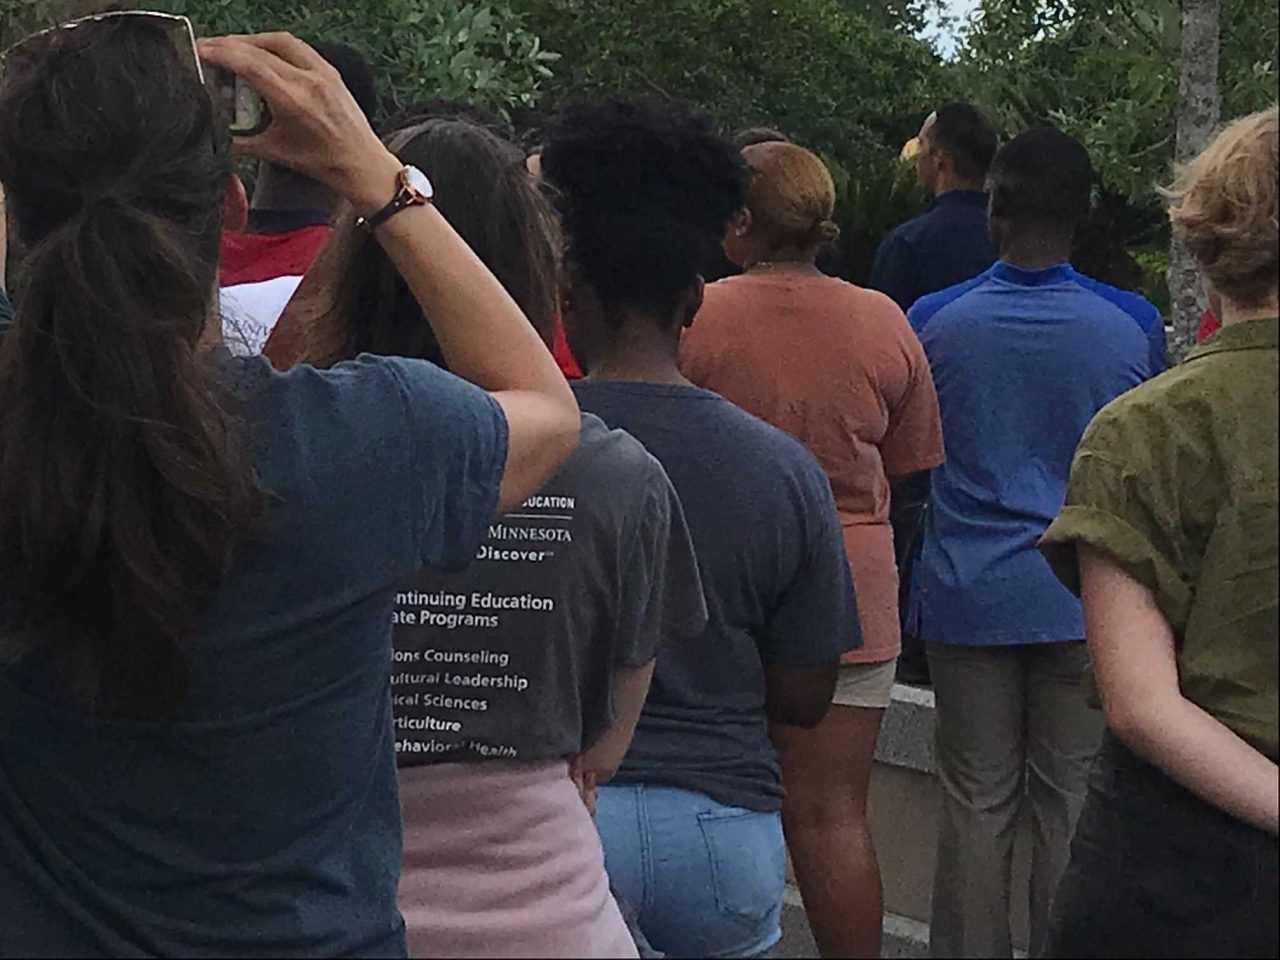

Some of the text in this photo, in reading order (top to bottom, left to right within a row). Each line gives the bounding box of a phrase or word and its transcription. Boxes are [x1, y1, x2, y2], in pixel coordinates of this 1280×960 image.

[522, 496, 575, 509] UCATION
[393, 591, 553, 611] ntinuing Education
[421, 611, 498, 628] Programs
[424, 649, 509, 667] Counseling
[445, 673, 528, 690] Leadership
[424, 696, 488, 711] Sciences
